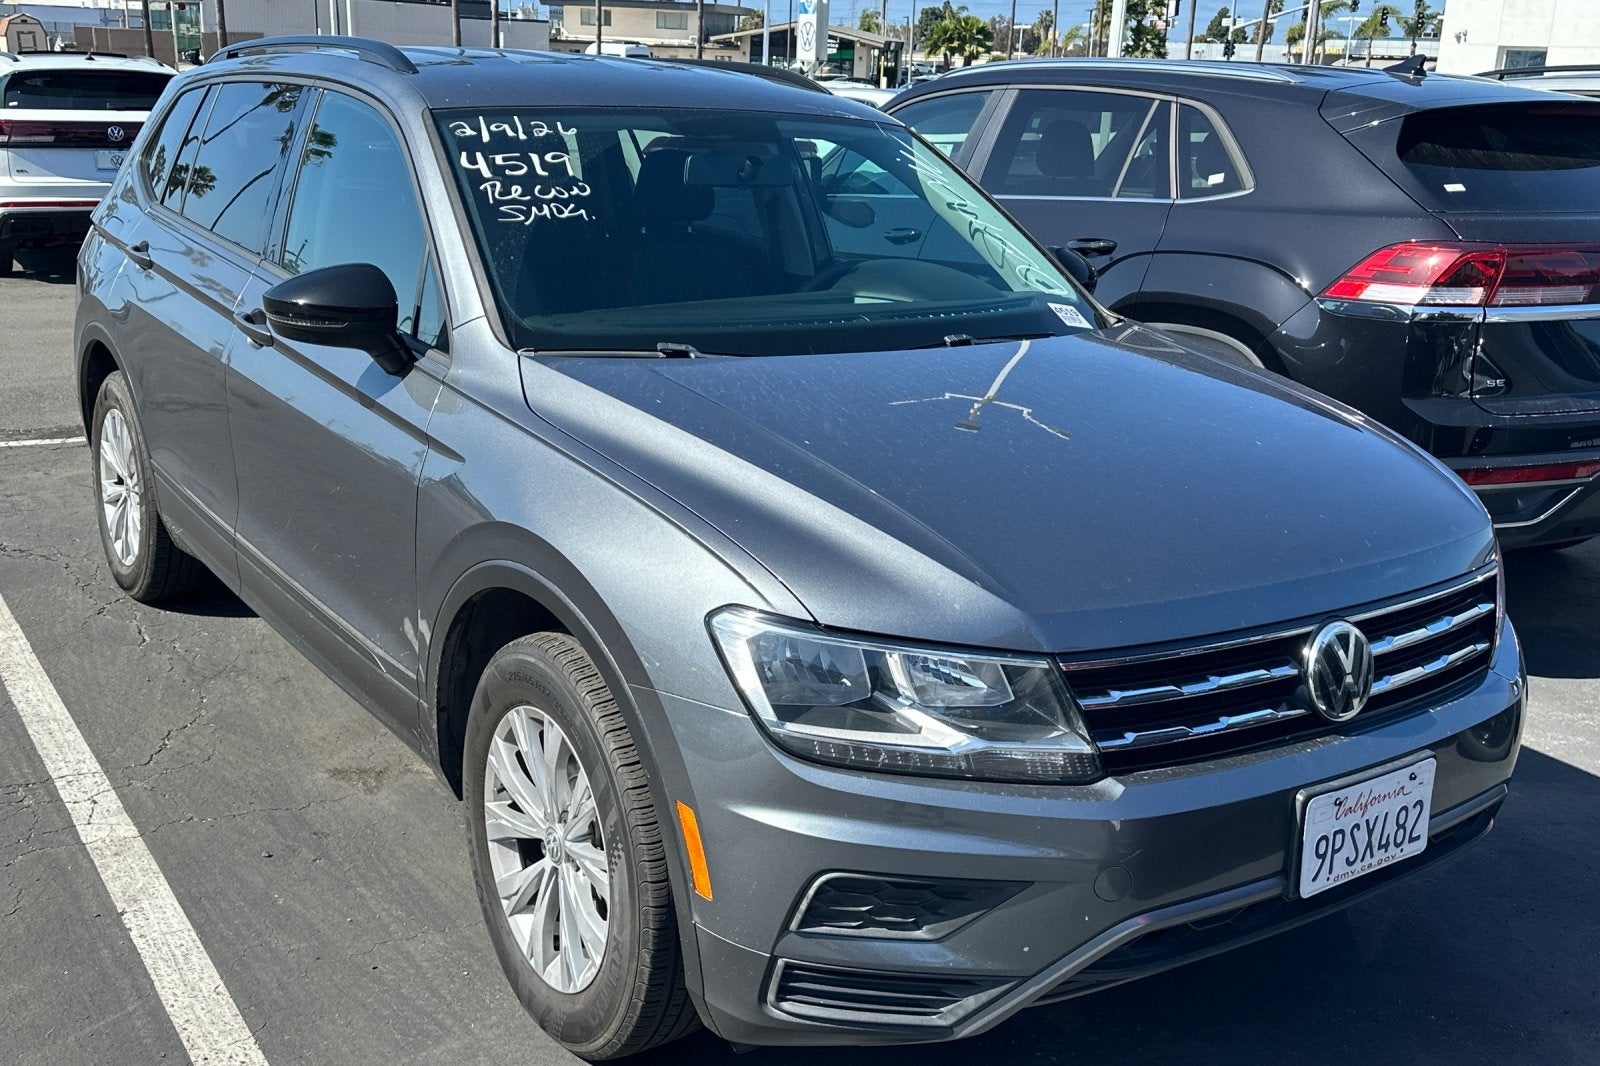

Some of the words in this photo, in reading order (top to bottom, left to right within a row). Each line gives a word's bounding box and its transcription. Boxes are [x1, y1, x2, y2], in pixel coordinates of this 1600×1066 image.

[449, 115, 578, 143] 2/9/26
[460, 151, 574, 179] 4519
[1486, 378, 1506, 388] SE
[1333, 785, 1412, 821] California
[1311, 799, 1424, 883] 9PSX482
[1333, 852, 1398, 883] dmv.ca.gov
